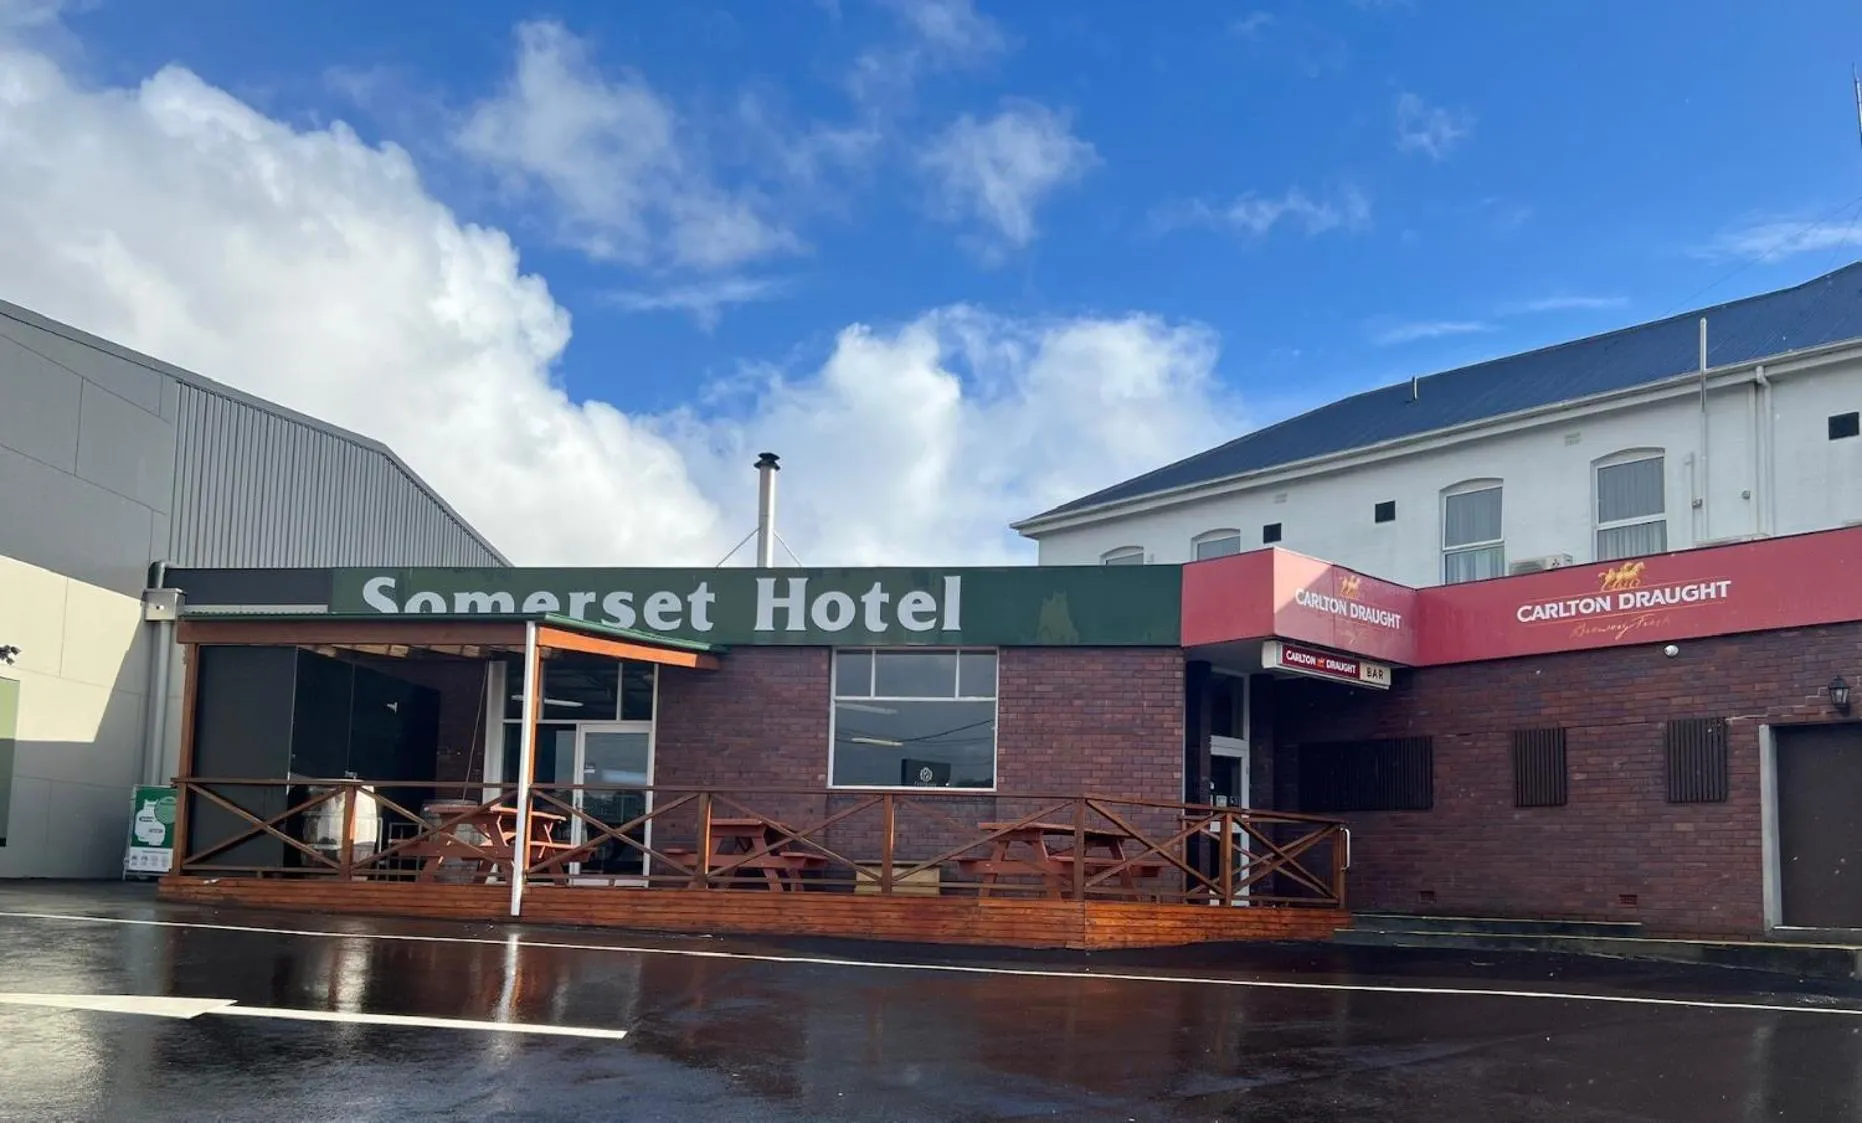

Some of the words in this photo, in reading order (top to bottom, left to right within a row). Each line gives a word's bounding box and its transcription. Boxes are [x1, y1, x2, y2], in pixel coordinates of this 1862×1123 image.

[754, 575, 962, 633] Hotel
[1295, 588, 1348, 616] CARLTON
[1349, 602, 1401, 629] DRAUGHT
[1516, 597, 1611, 623] CARLTON
[1618, 580, 1732, 610] DRAUGHT
[1285, 650, 1316, 666] CARLTON
[1326, 659, 1356, 674] DRAUGHT
[1366, 667, 1384, 680] BAR
